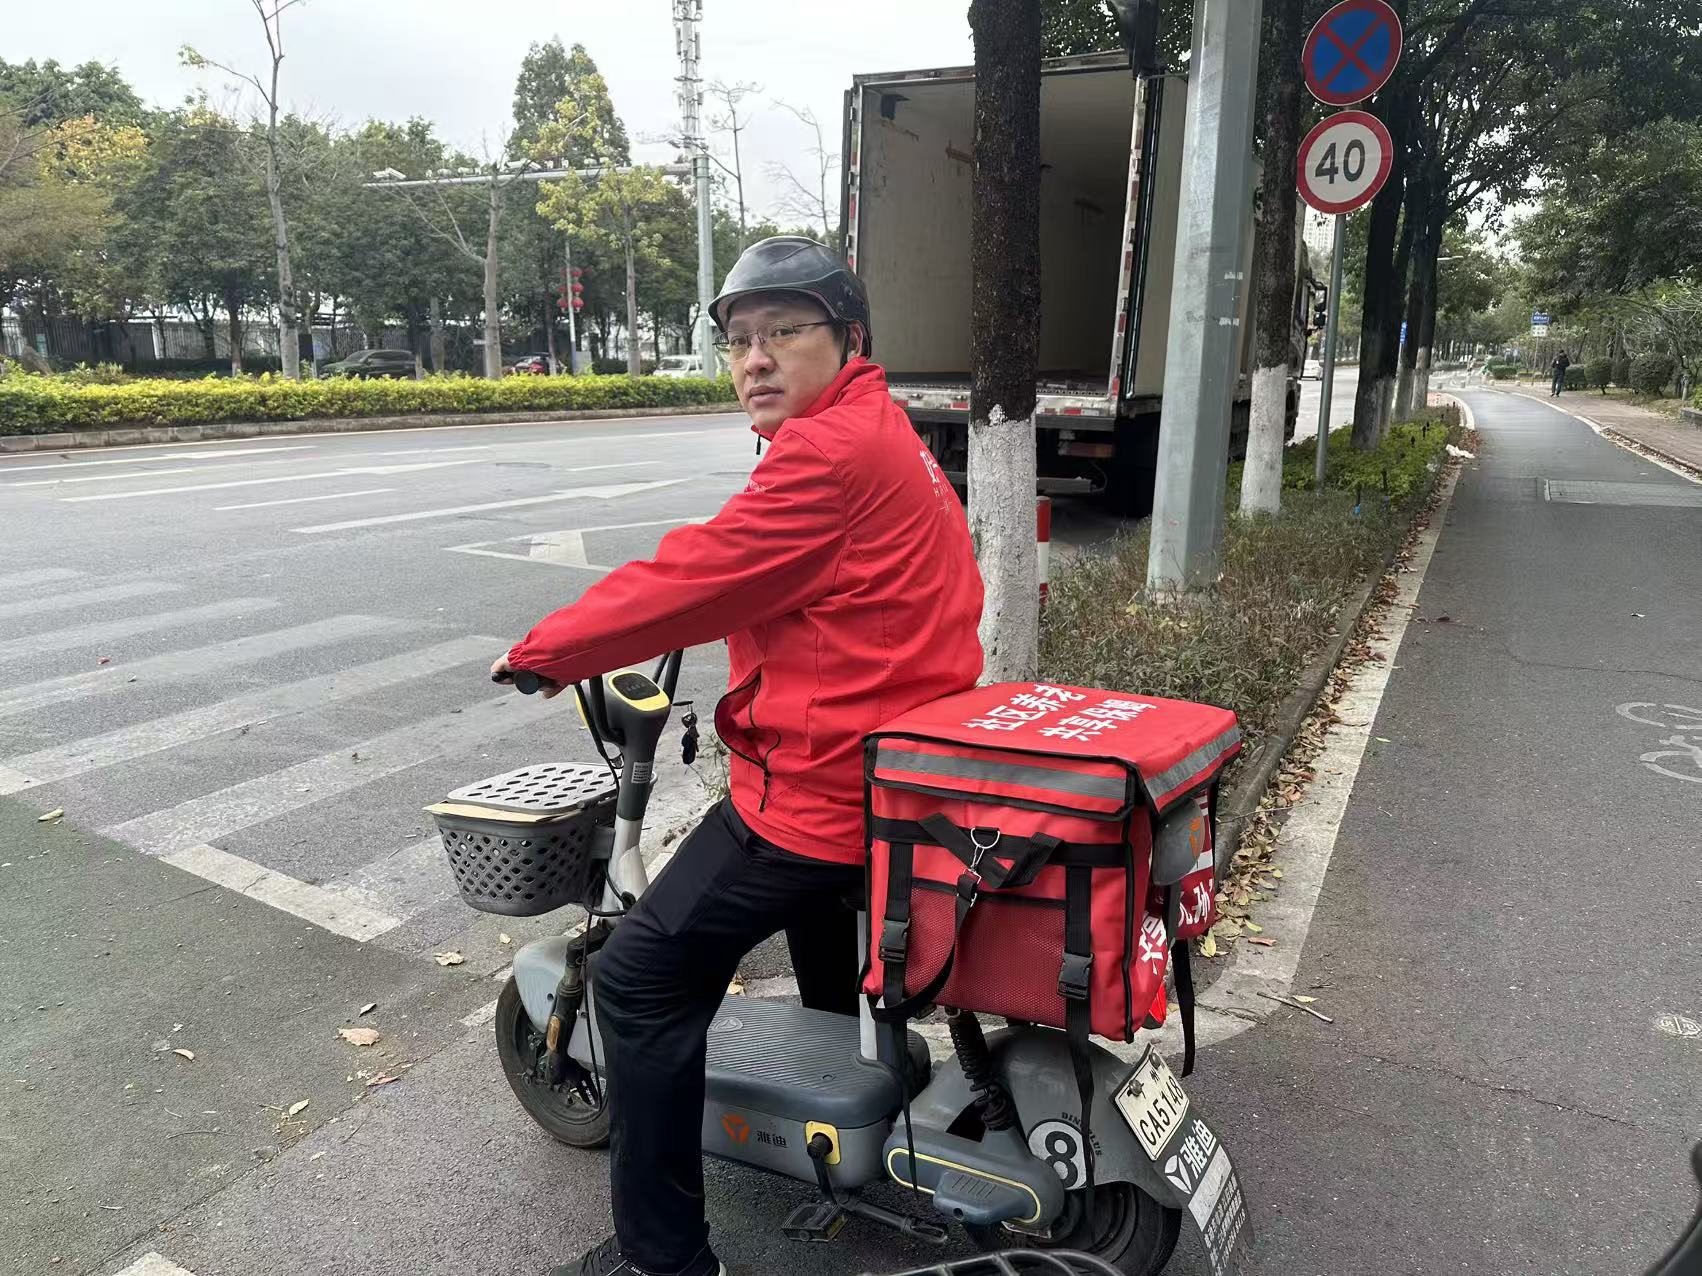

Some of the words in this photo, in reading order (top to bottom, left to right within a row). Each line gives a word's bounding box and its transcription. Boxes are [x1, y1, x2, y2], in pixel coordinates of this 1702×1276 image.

[1315, 139, 1366, 185] 40
[961, 684, 1088, 731] 社区养老
[1139, 1075, 1184, 1147] CA5148
[756, 1130, 789, 1149] 雅迪
[1180, 1119, 1217, 1180] 雅迪
